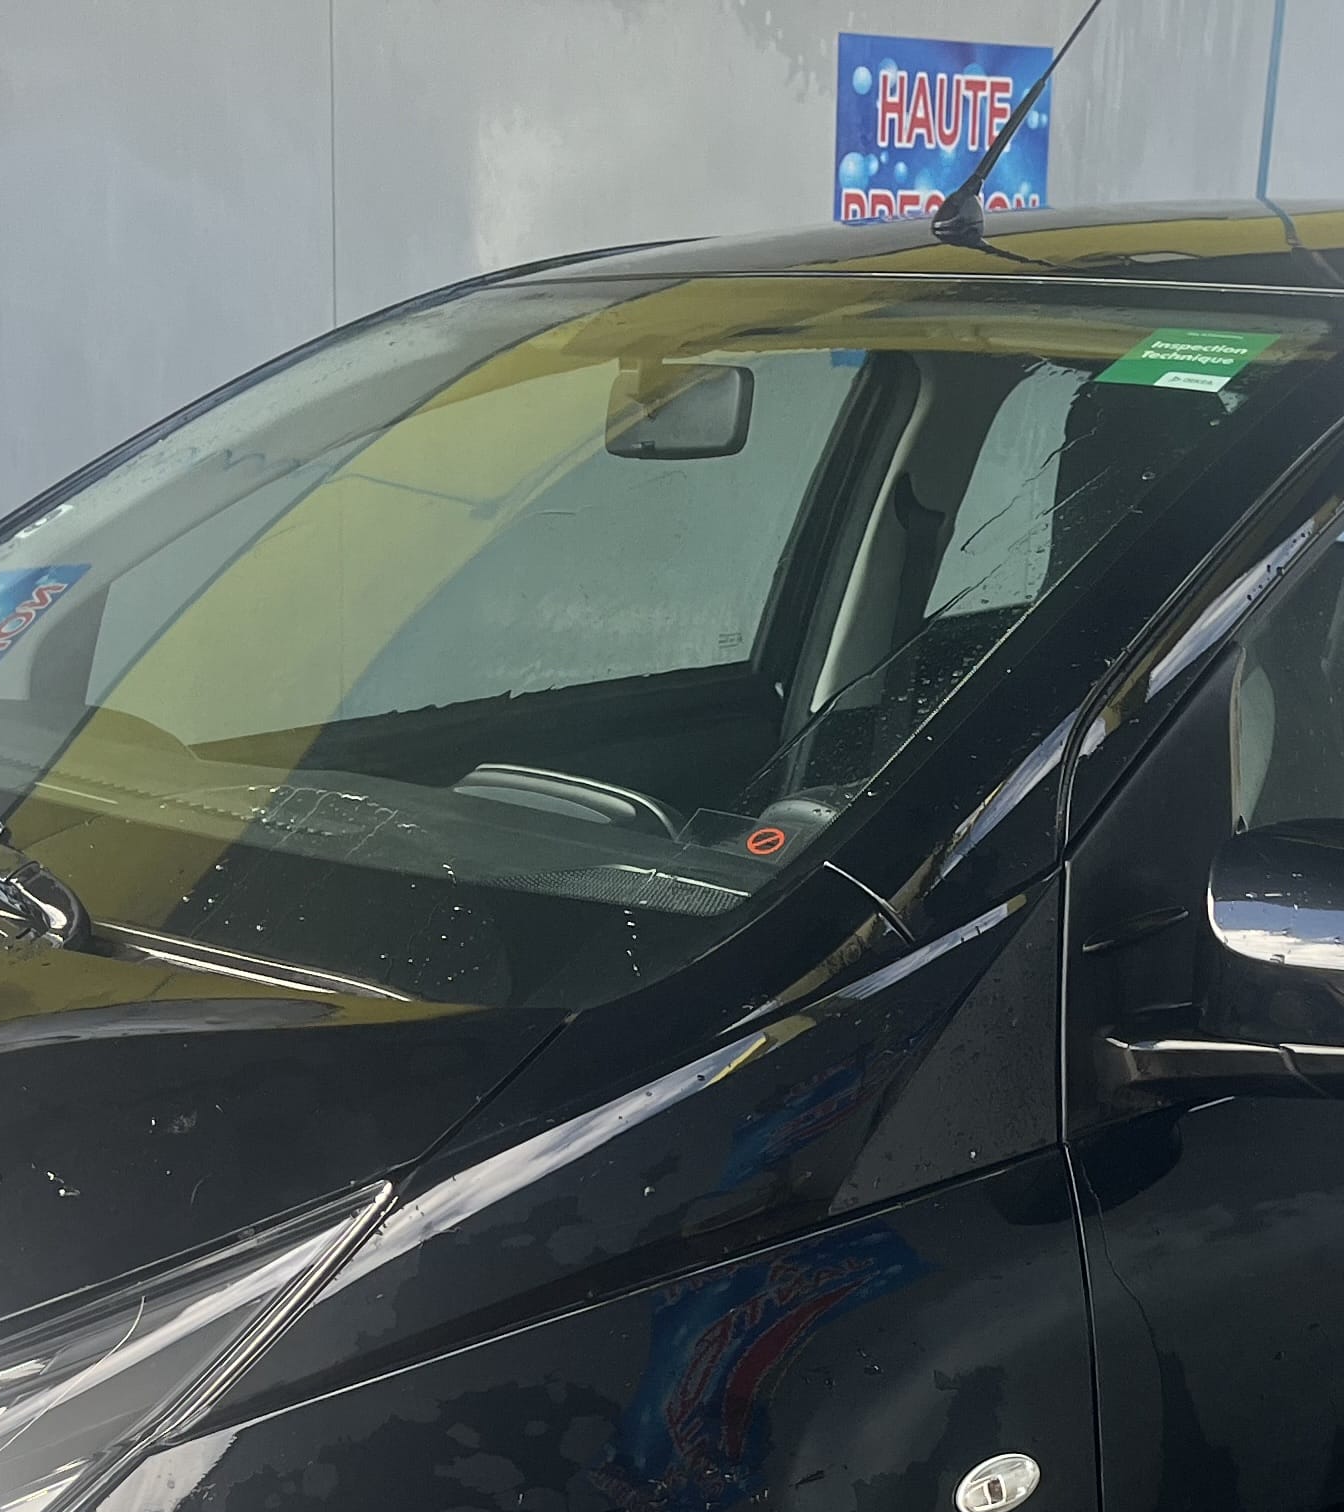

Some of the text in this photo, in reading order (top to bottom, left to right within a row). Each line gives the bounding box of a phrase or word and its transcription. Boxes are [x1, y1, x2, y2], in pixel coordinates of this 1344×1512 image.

[878, 71, 1013, 150] HAUTE
[1151, 340, 1248, 355] Inspection
[1141, 350, 1234, 365] Technique
